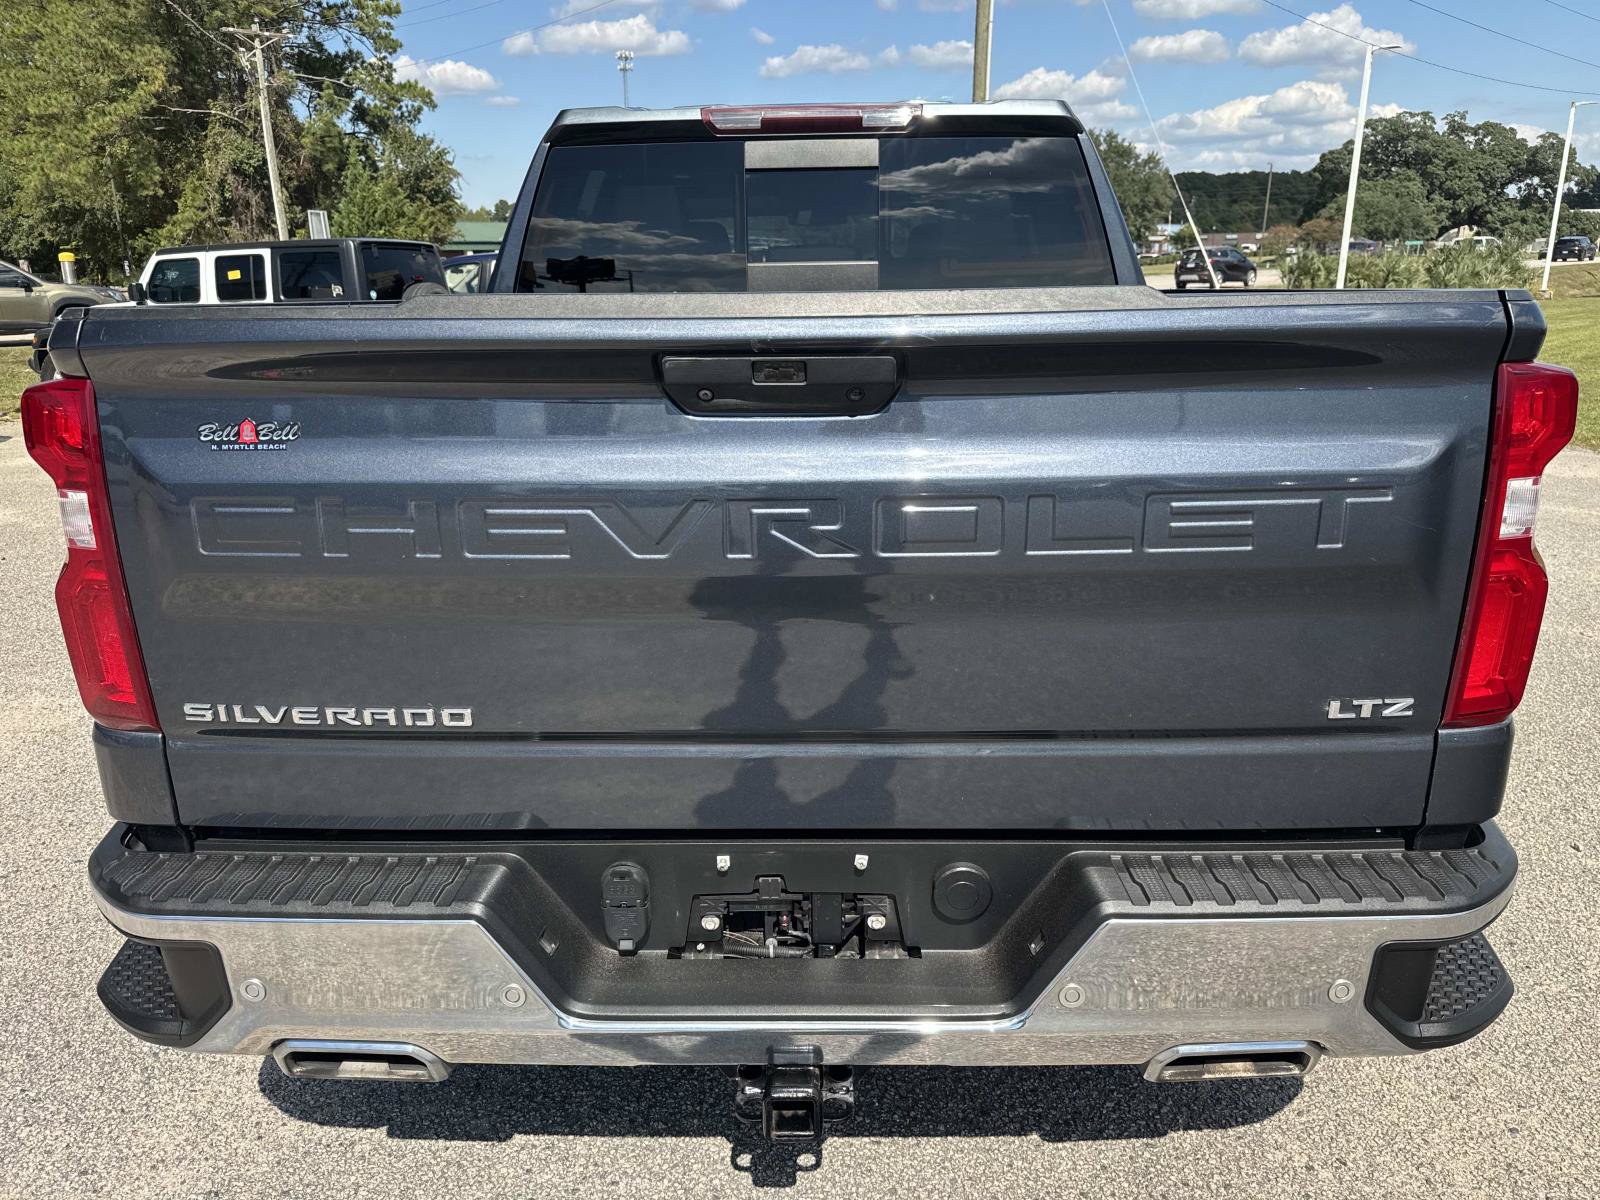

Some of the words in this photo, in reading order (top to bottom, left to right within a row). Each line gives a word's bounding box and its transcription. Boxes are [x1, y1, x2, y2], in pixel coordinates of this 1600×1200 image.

[198, 423, 239, 441] Bell
[257, 423, 300, 441] Bell
[190, 485, 1395, 560] CHEVROLET
[183, 702, 474, 727] SILVERADO
[1327, 697, 1415, 719] LTZ
